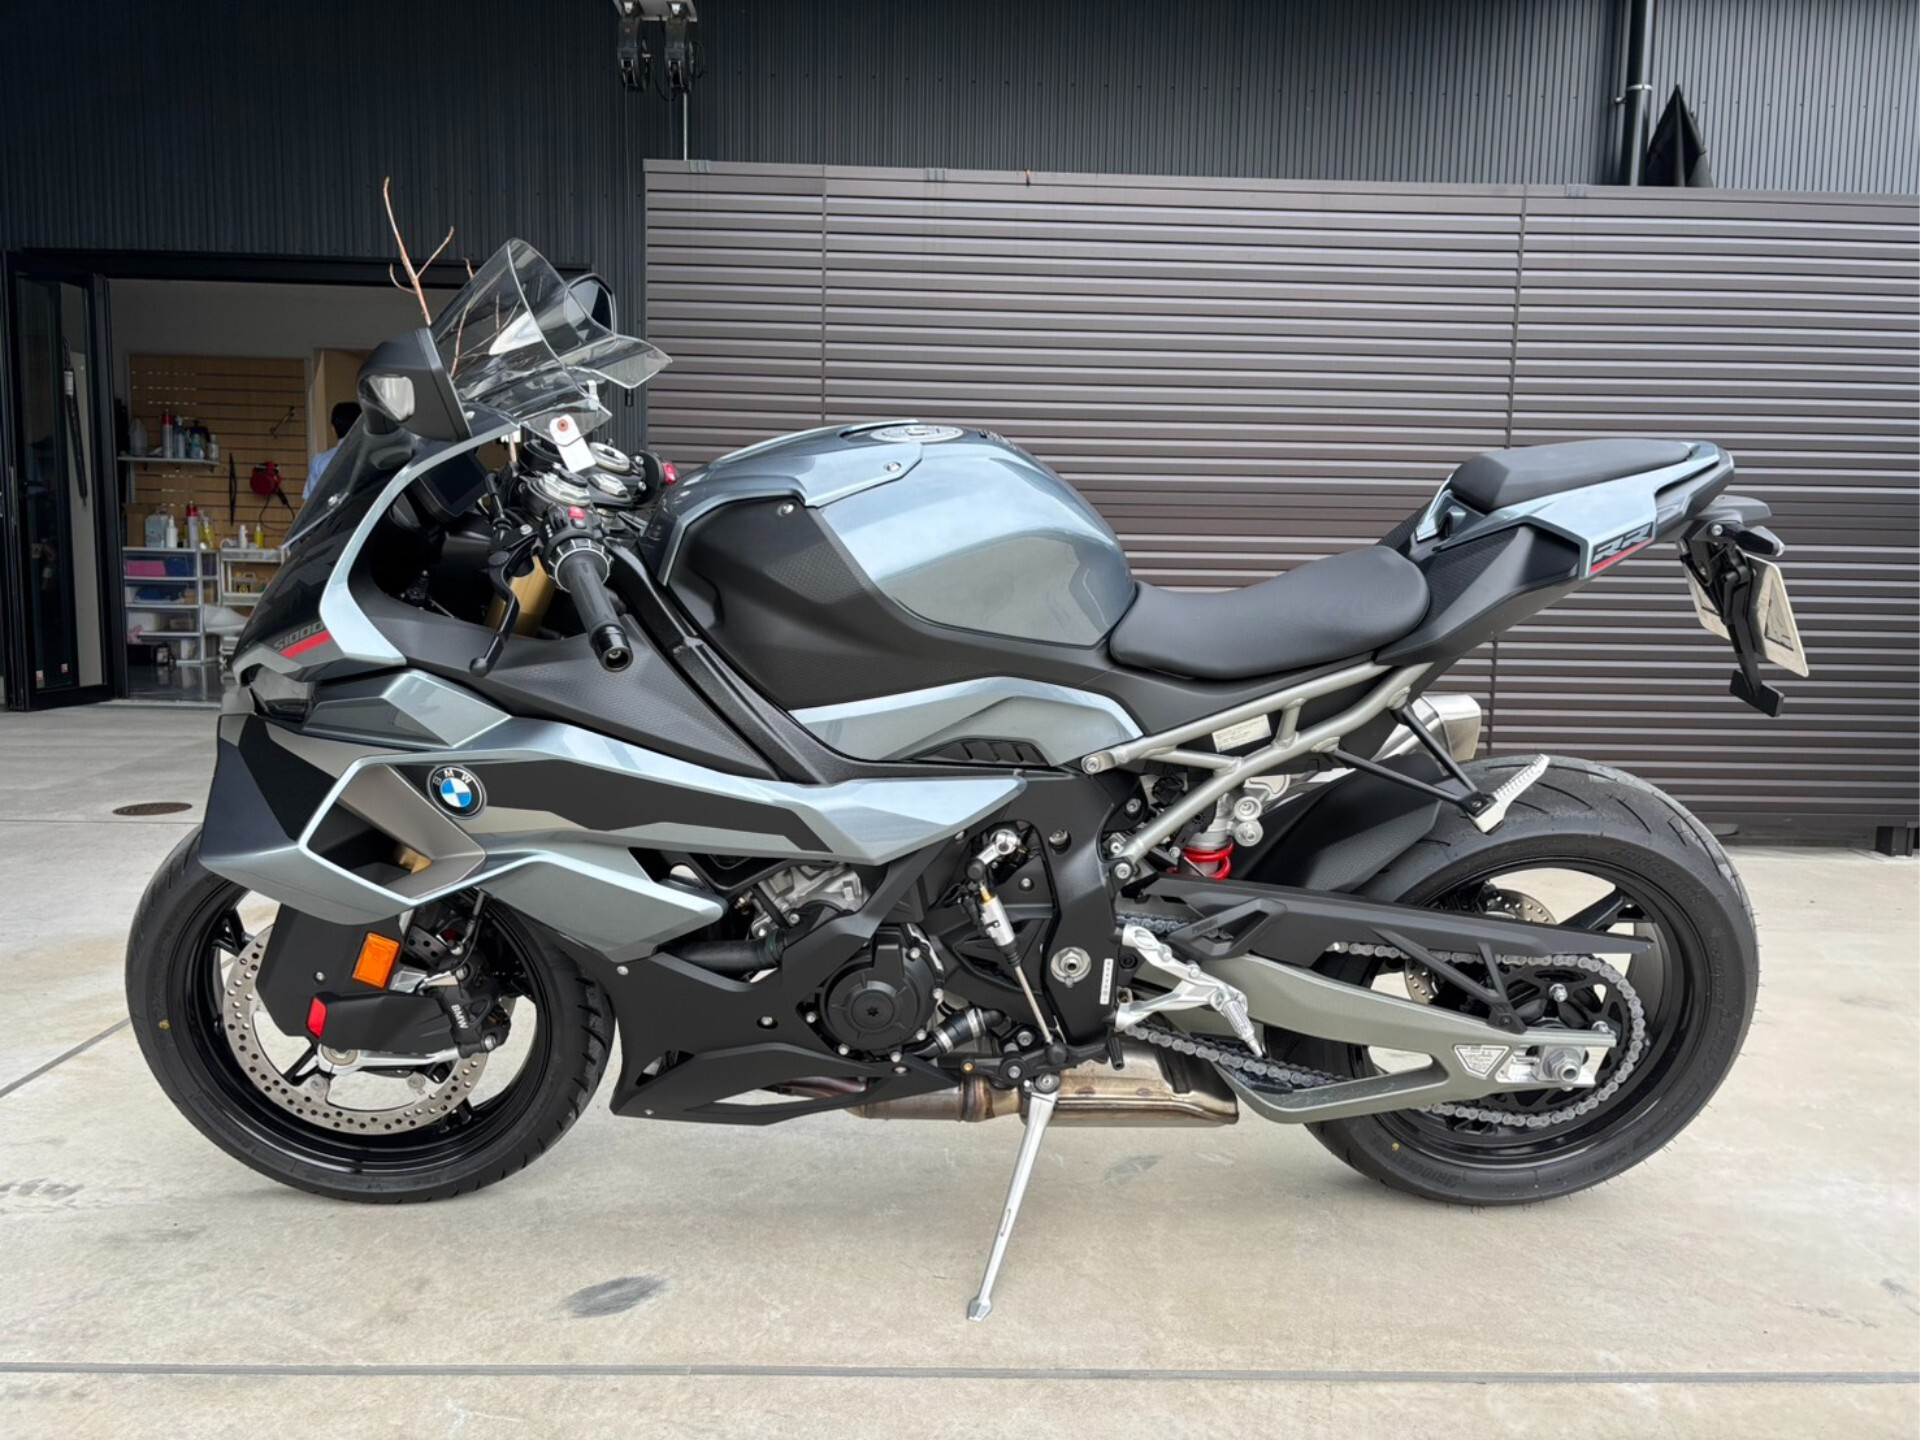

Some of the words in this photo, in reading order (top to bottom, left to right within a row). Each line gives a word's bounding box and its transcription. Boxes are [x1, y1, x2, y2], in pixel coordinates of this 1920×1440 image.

[1593, 523, 1653, 563] RR
[272, 621, 325, 651] S1000
[433, 768, 473, 786] BMW
[451, 1004, 469, 1029] BMW
